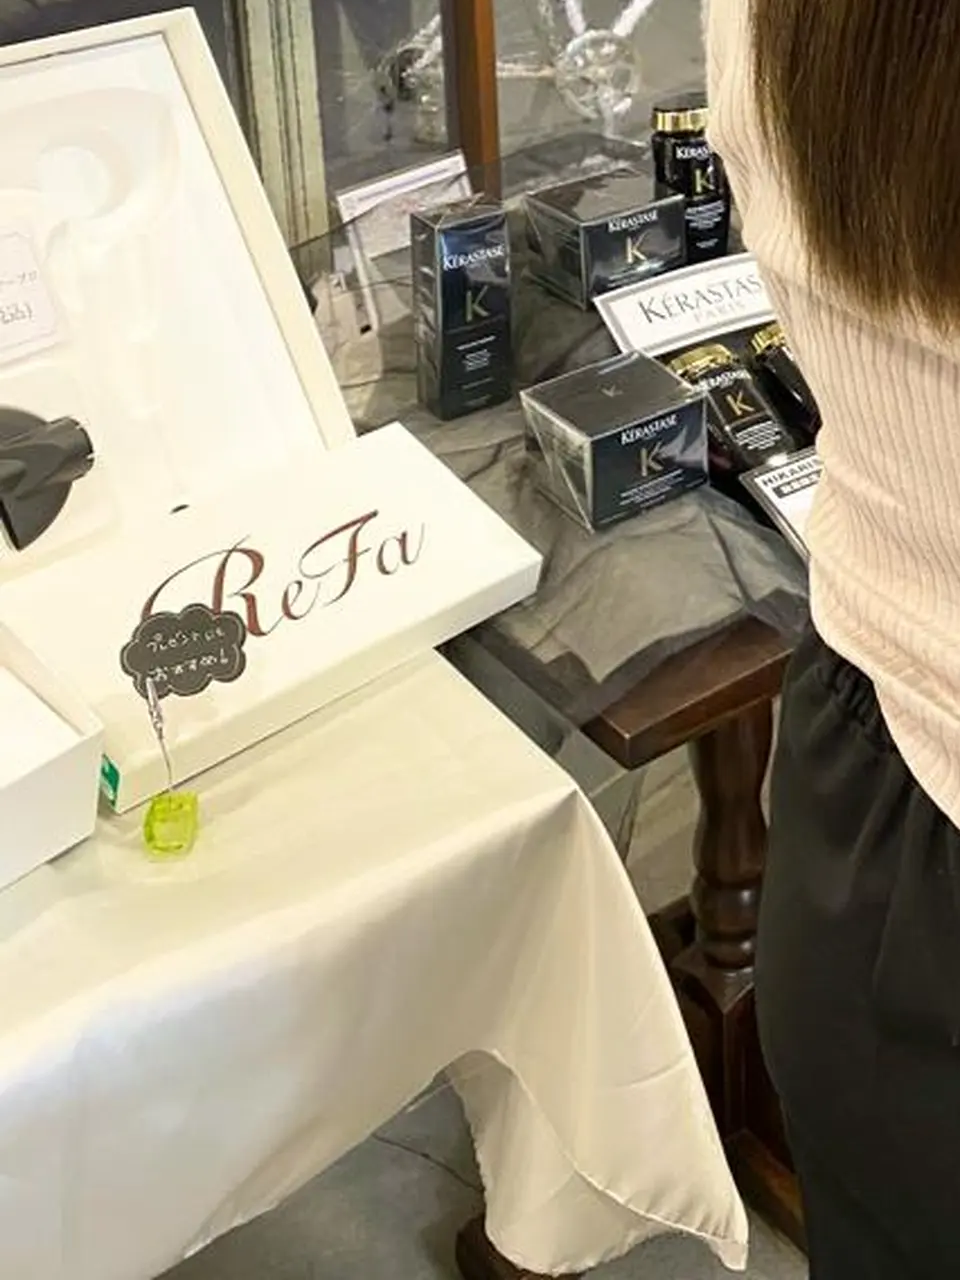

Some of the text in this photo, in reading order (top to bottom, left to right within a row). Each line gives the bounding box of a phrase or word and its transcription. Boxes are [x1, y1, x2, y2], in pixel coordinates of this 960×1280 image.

[625, 230, 650, 264] K
[464, 284, 491, 323] K
[725, 388, 756, 417] K
[640, 440, 664, 478] K
[141, 509, 426, 638] ReFa
